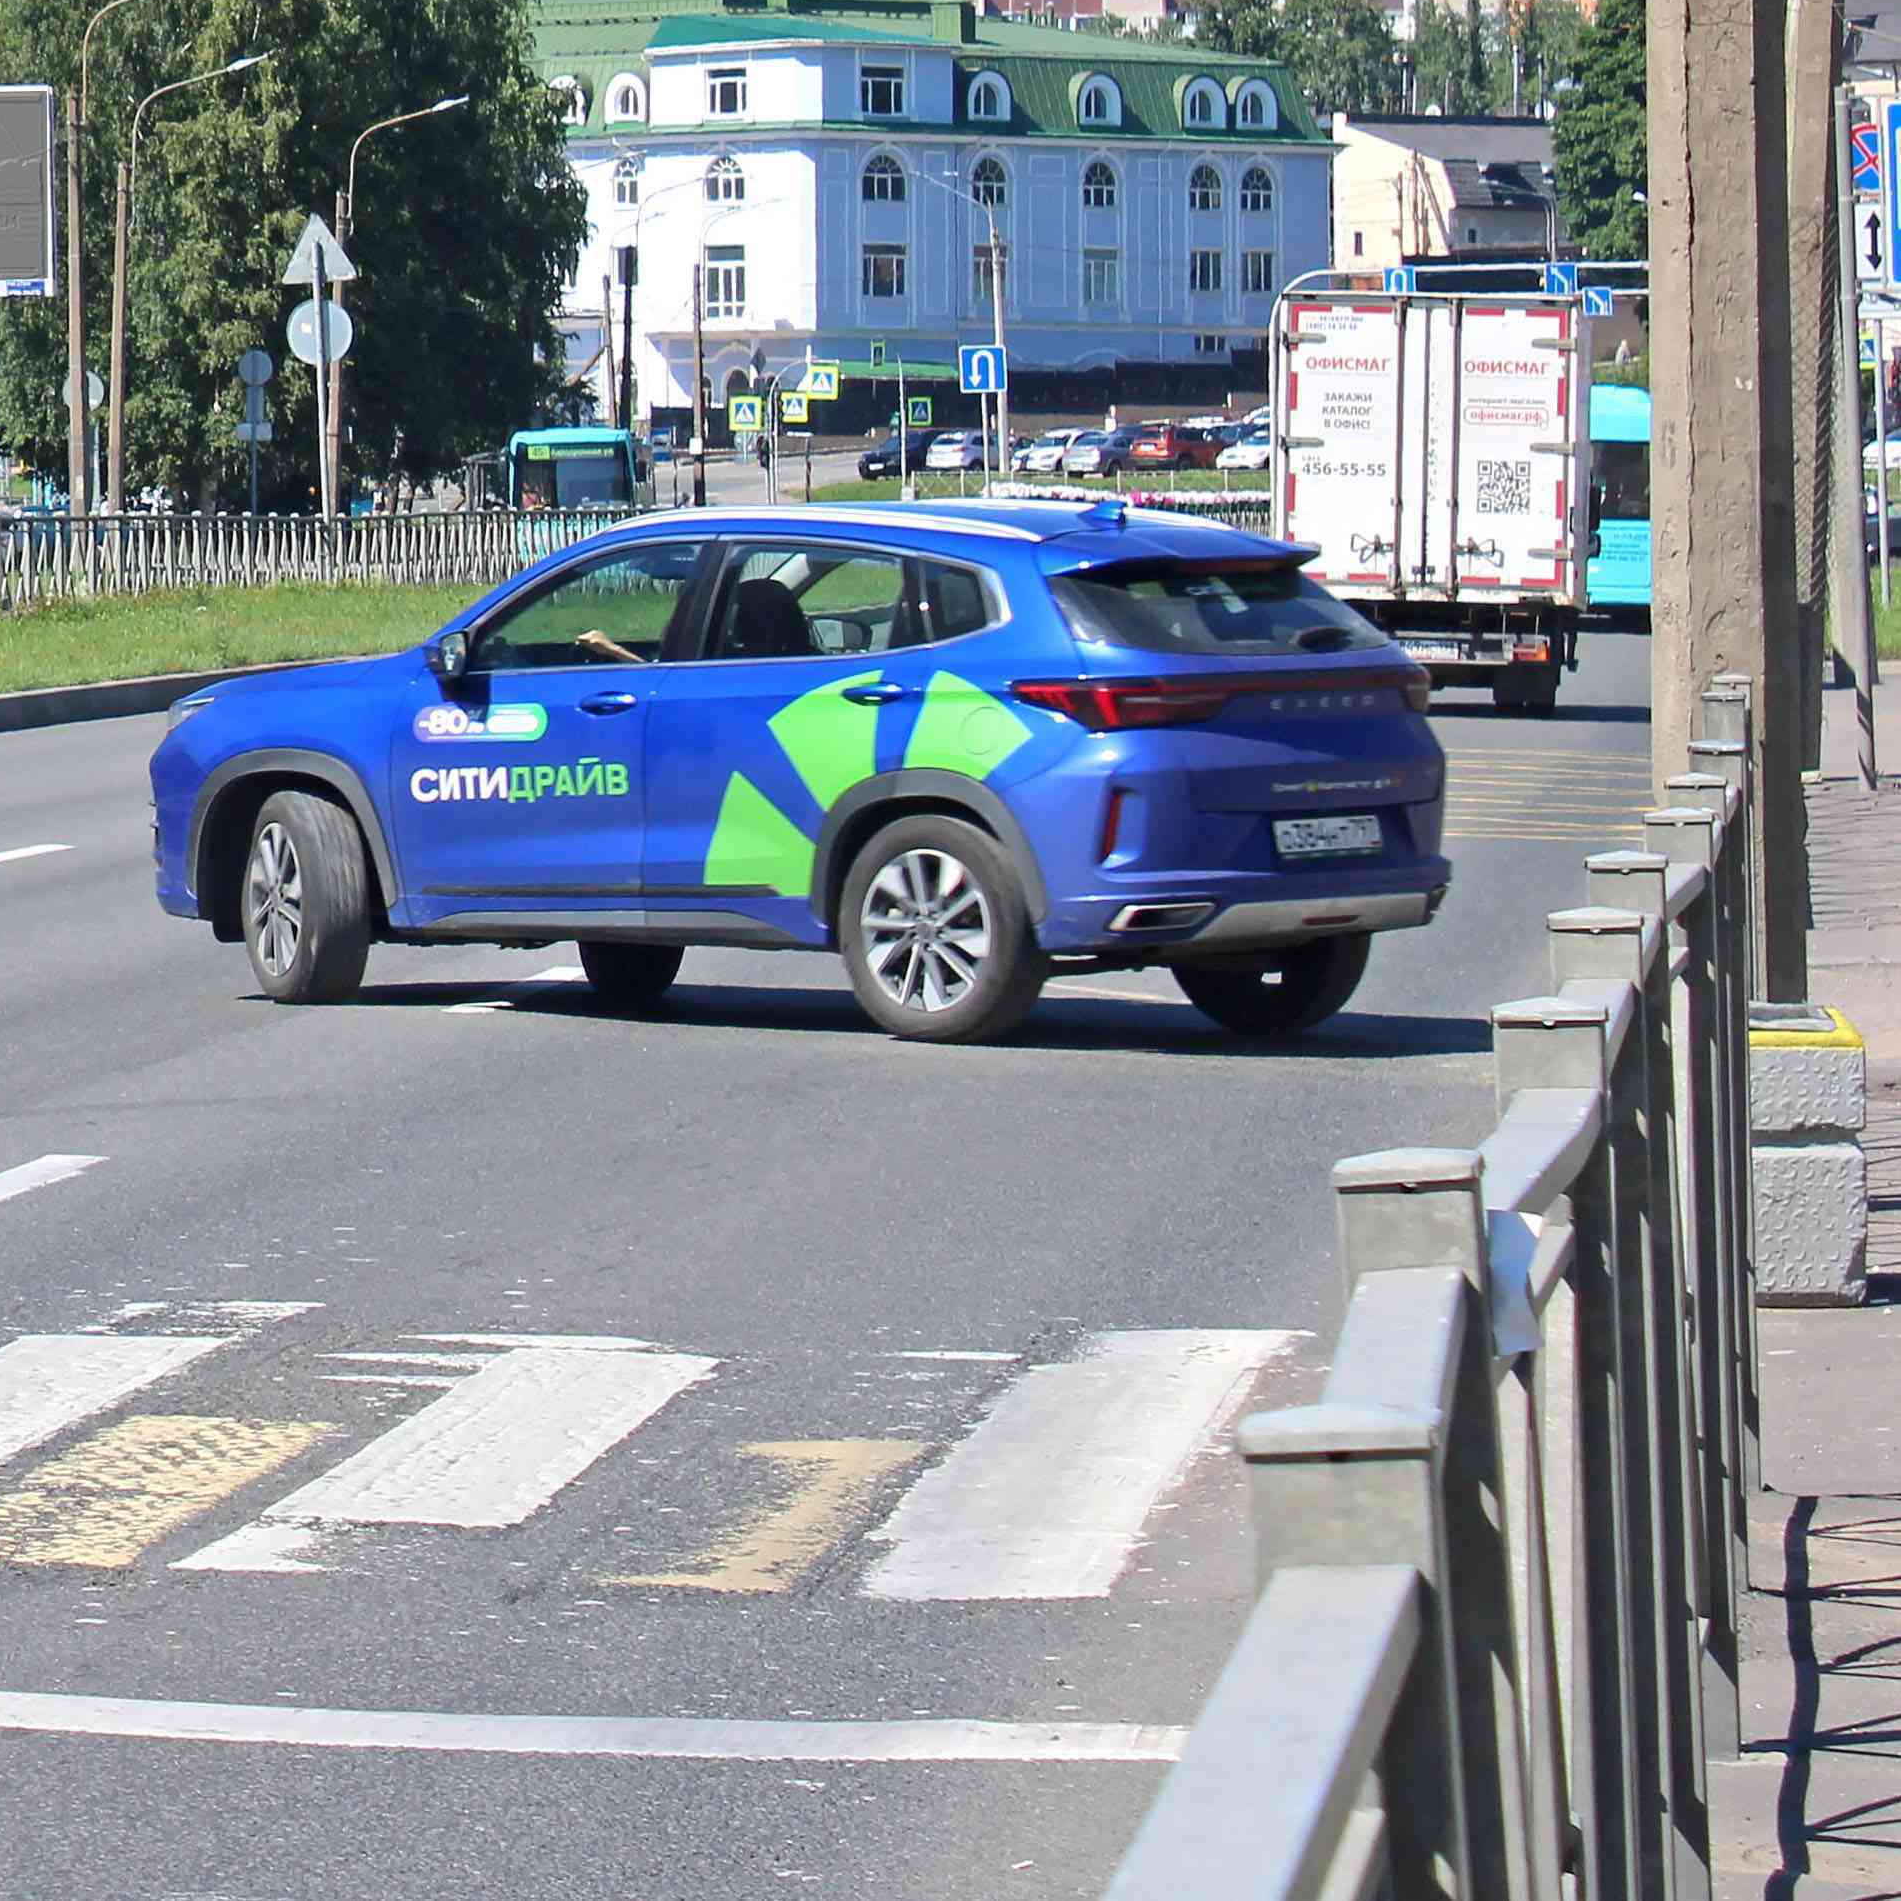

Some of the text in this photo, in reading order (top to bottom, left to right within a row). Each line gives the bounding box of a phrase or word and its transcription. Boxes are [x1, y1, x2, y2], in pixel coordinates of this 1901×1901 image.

[1305, 356, 1391, 371] ОФИСМАГ
[1464, 359, 1551, 376] ОФИСМАГ
[1323, 392, 1373, 403] ЗАКАЖИ
[1322, 405, 1374, 416] КАТАЛОГ
[1470, 409, 1543, 422] офисмаг.рф
[1324, 418, 1371, 430] В ОФИС!
[1302, 462, 1387, 477] 456-55-55
[410, 756, 630, 804] СИТИДРАЙВ
